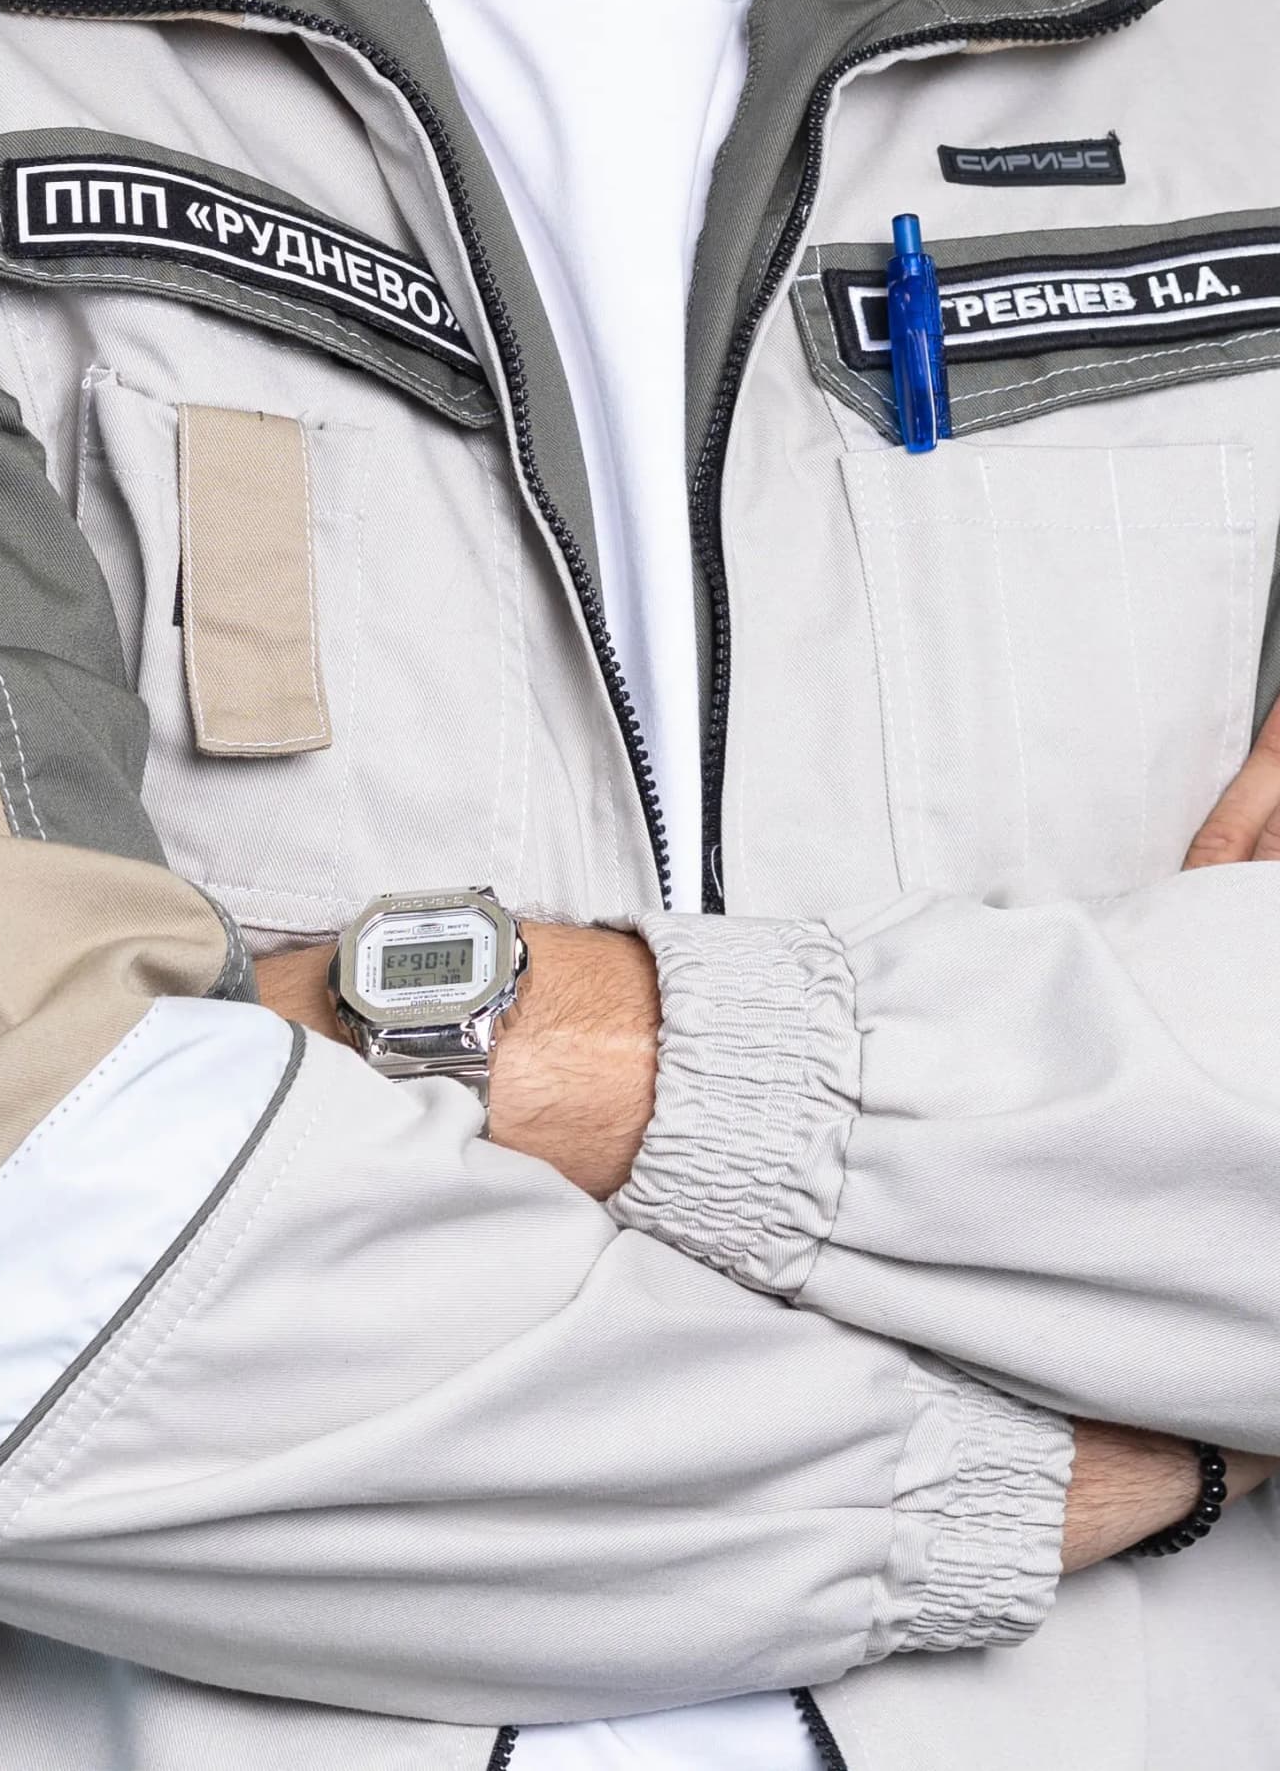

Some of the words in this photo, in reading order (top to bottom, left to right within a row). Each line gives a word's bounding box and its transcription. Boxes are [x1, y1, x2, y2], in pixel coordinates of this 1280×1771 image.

[956, 150, 1111, 172] СИРИУС
[45, 180, 169, 229] ППП
[1147, 265, 1241, 308] Н.А.
